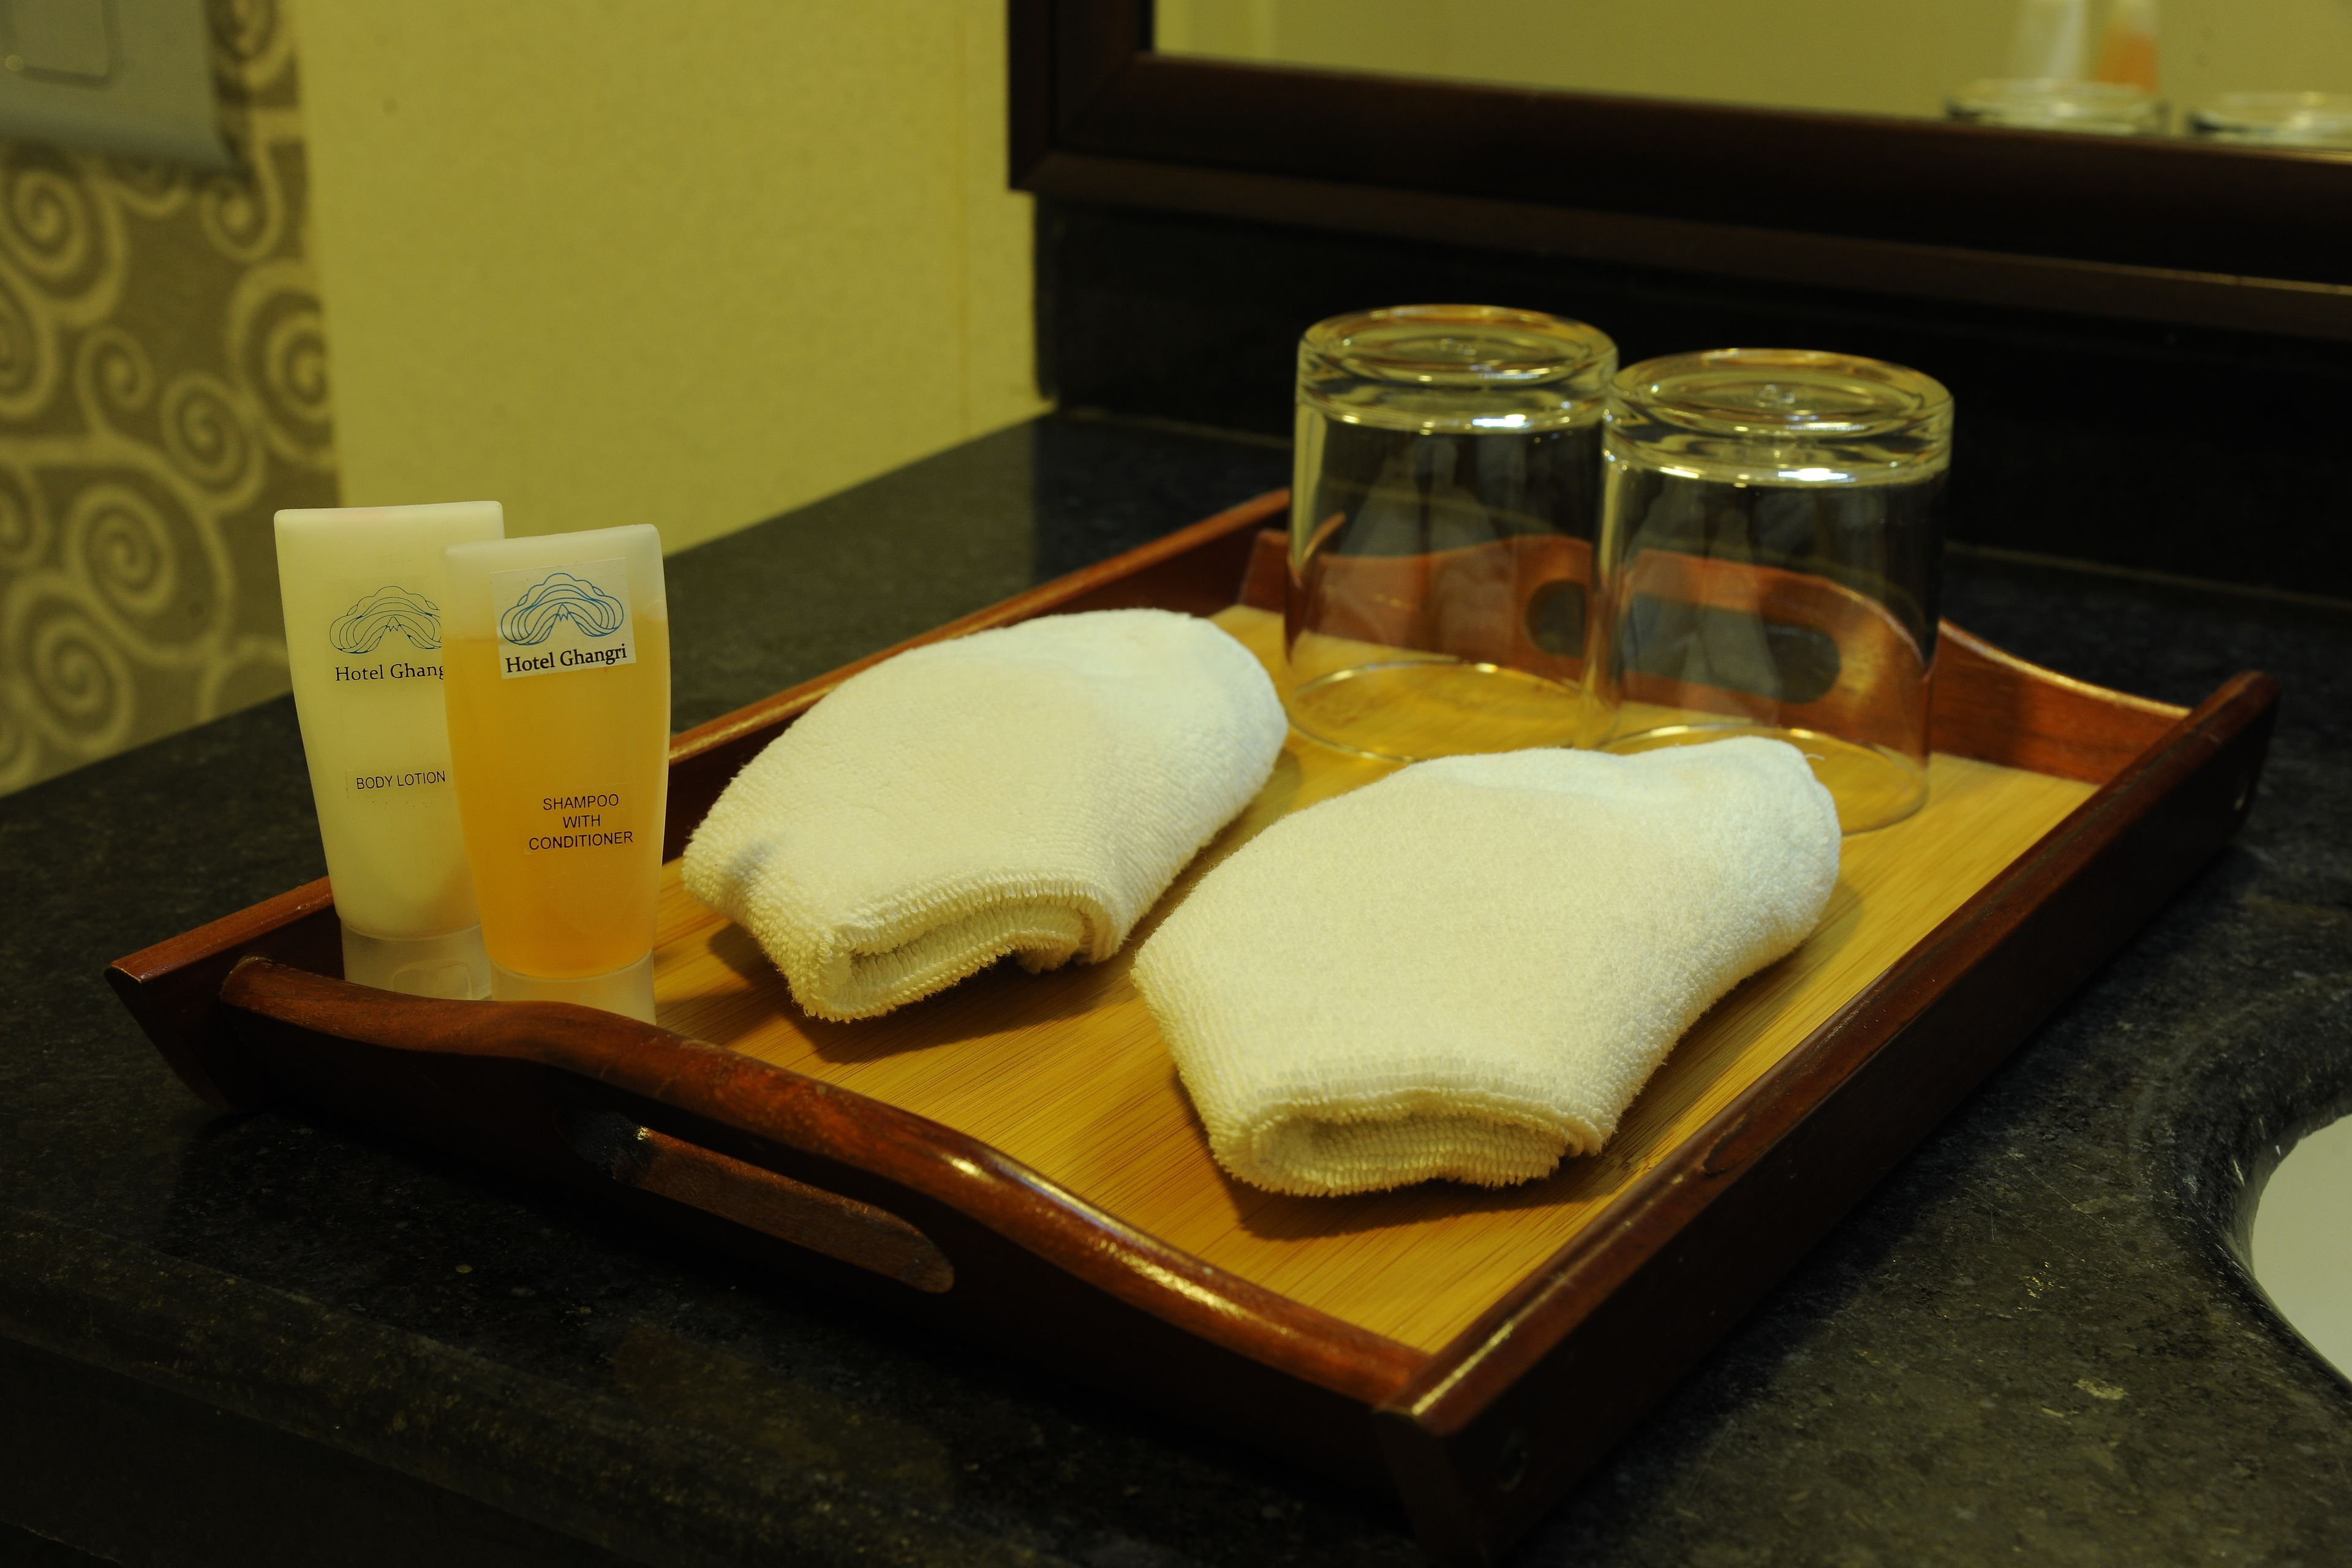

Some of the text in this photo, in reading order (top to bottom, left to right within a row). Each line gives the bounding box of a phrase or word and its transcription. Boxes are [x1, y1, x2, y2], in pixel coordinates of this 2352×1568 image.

[505, 643, 627, 673] Hotel Ghangri
[334, 664, 385, 682] Hotel
[356, 771, 446, 790] BODY LOTION
[543, 793, 619, 810] SHAMPOO
[562, 814, 601, 829] WITH
[529, 831, 633, 850] CONDITIONER
